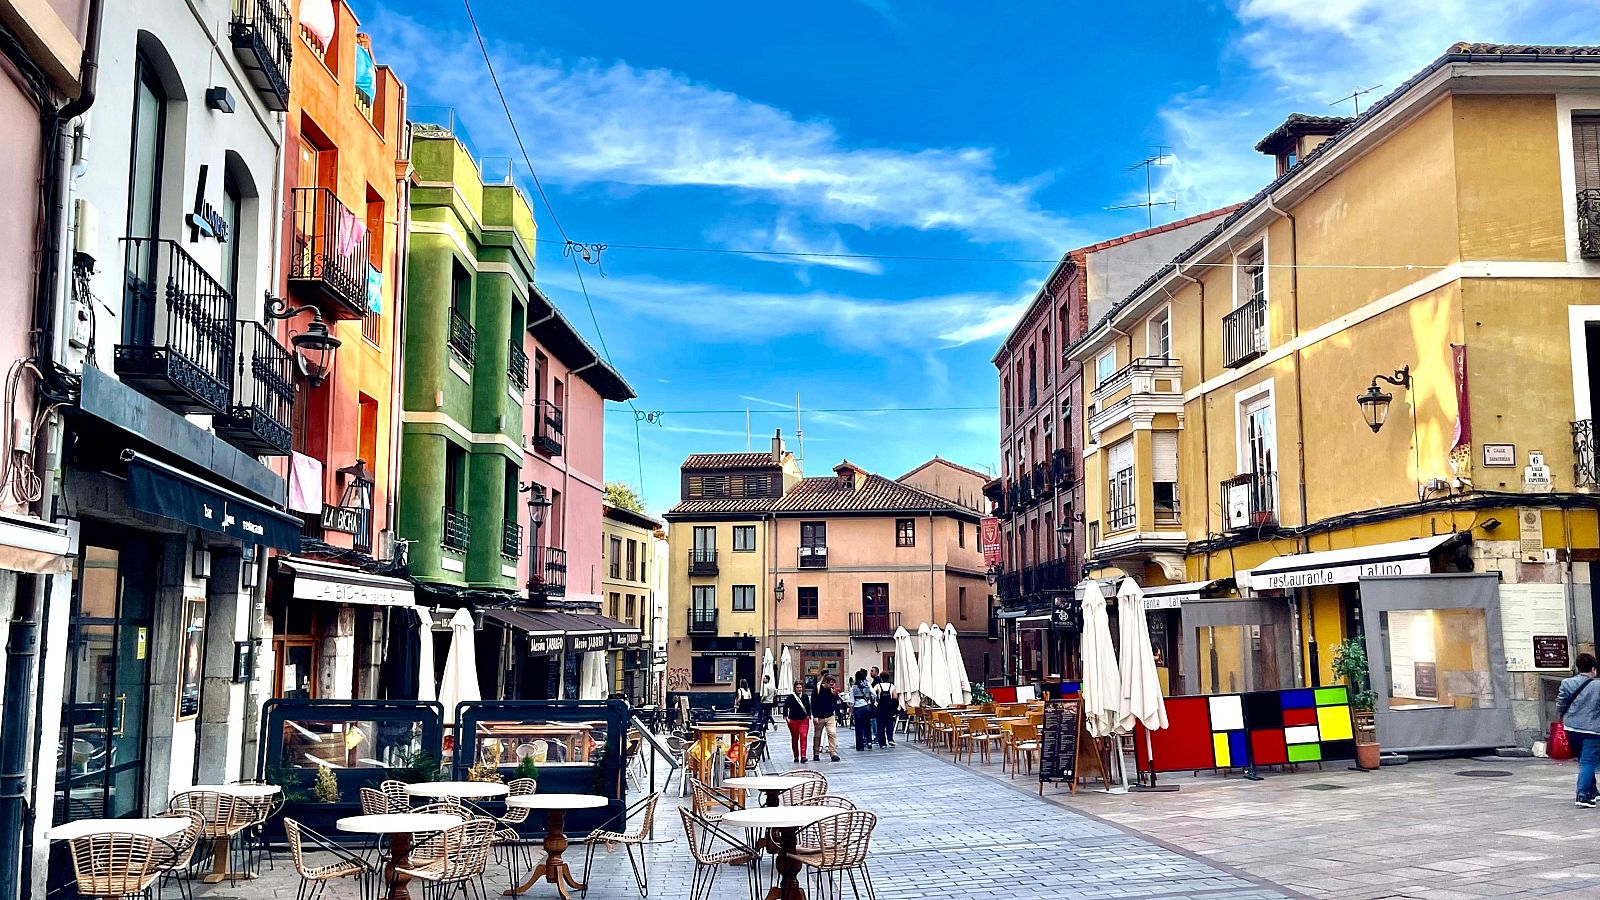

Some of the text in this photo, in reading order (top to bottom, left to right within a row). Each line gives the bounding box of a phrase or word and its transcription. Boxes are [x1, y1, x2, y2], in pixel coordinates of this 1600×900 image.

[1532, 456, 1539, 465] 6
[323, 506, 358, 533] LA BICHA
[1269, 570, 1334, 588] restaurante
